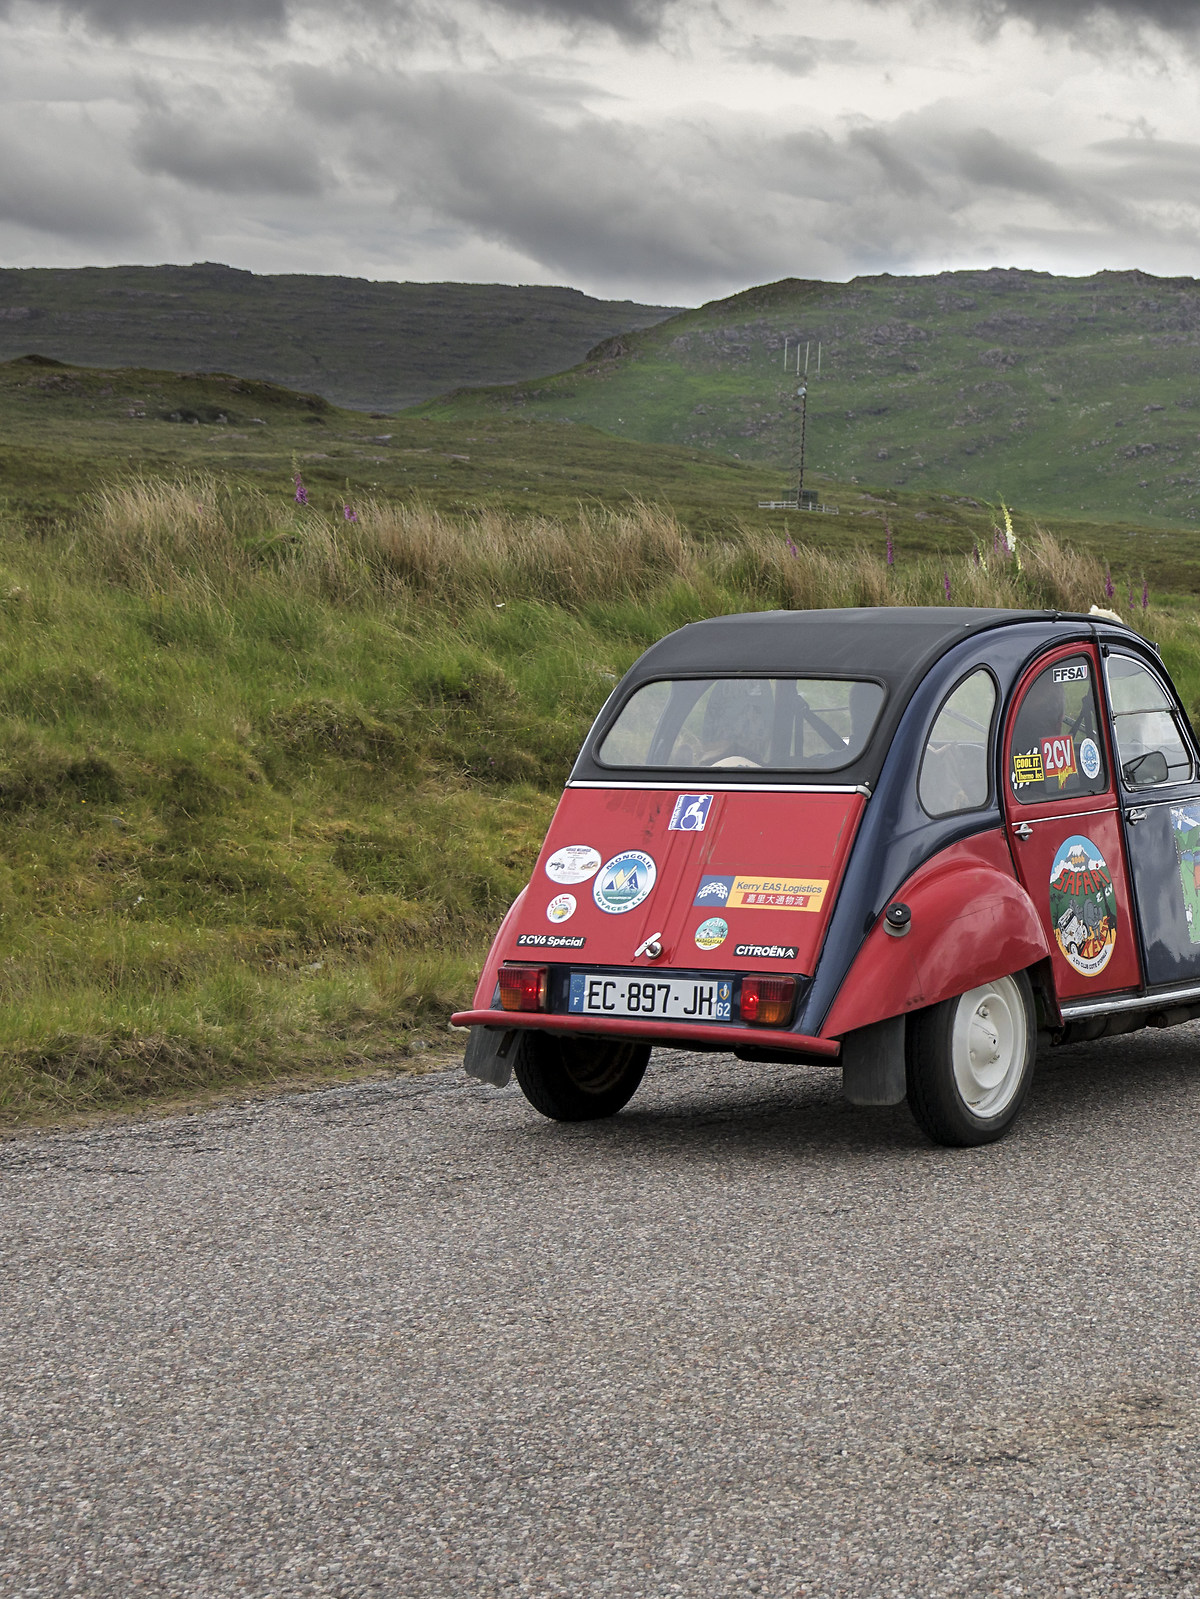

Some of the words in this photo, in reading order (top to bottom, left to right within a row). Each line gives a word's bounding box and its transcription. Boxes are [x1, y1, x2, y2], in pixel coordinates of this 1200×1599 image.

[1053, 667, 1084, 682] FFSA
[1043, 739, 1071, 770] 2CV
[1016, 758, 1033, 769] COOL
[1033, 757, 1040, 767] IT
[606, 853, 653, 870] MONGOLIE
[736, 881, 761, 893] Kerry
[762, 882, 782, 892] EAS
[783, 883, 823, 895] Logistics
[1053, 868, 1111, 896] SAFARI
[595, 890, 629, 911] VOYAGES
[631, 890, 648, 905] LLC
[746, 894, 804, 906] 嘉里大通物流
[547, 936, 584, 947] Spécial
[736, 945, 786, 958] CITROËN
[573, 997, 580, 1006] F
[717, 1002, 730, 1017] 62
